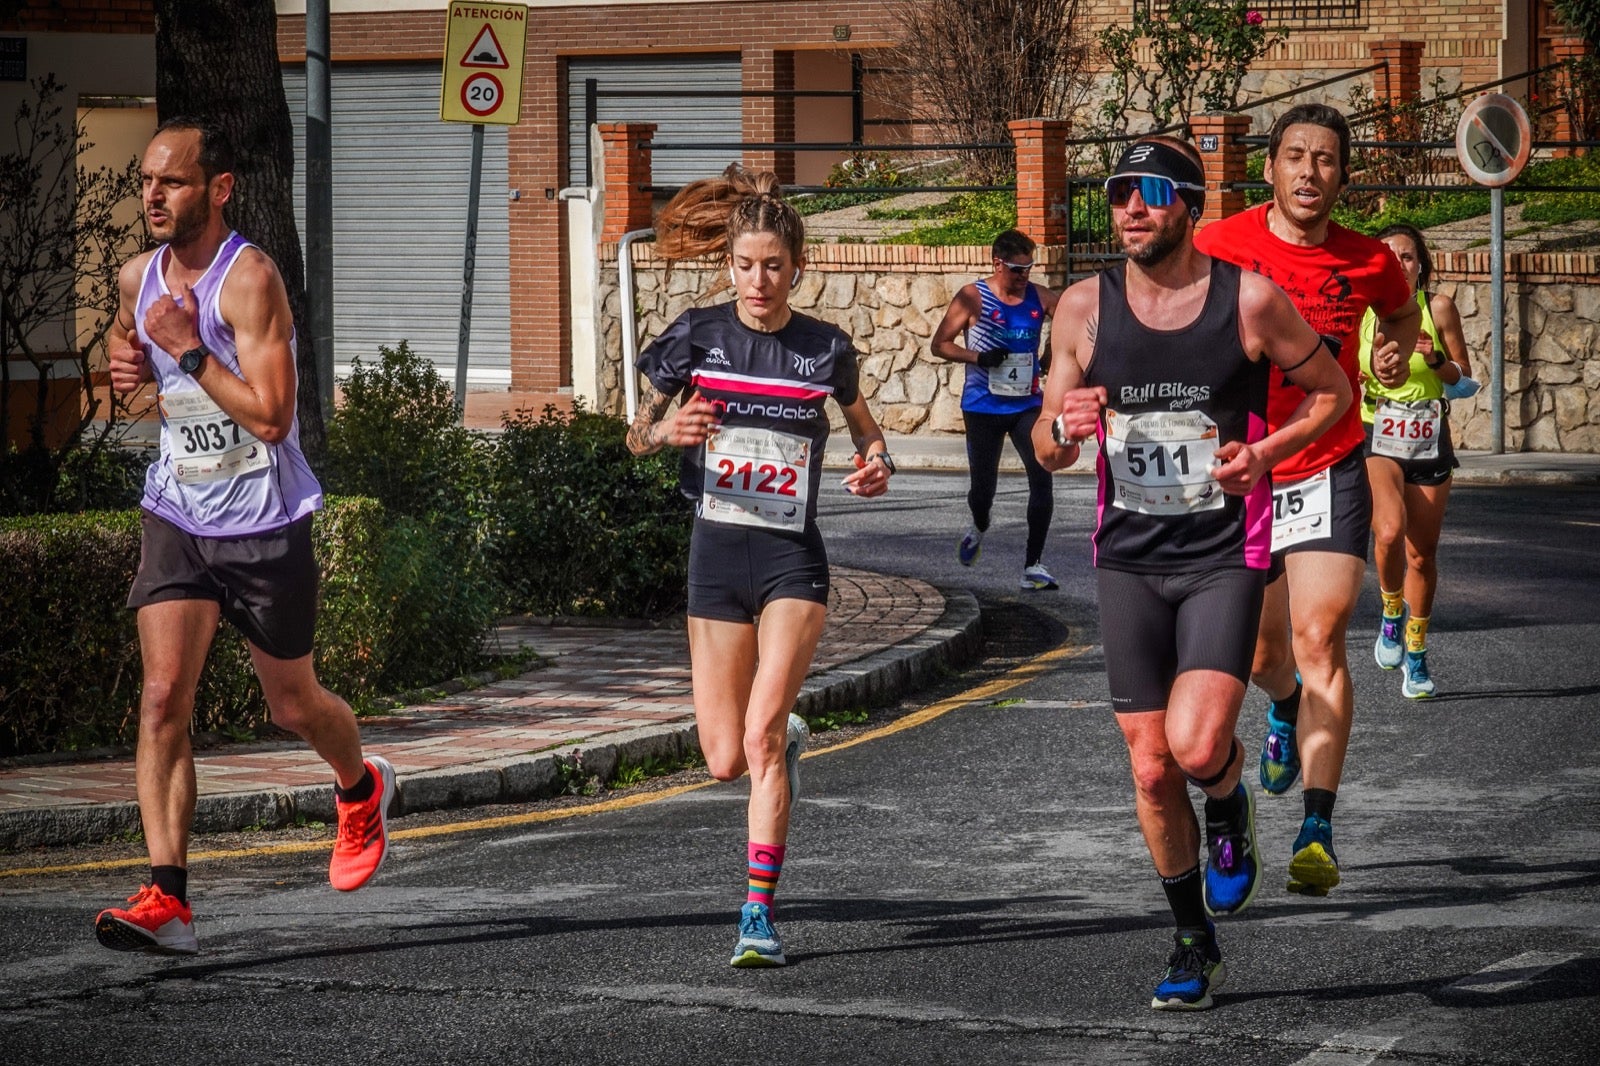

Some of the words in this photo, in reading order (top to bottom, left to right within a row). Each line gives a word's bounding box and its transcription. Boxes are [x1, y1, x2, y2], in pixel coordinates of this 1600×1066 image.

[453, 7, 524, 21] ATENCIÓN
[470, 86, 495, 101] 20
[1008, 368, 1018, 381] 4
[1120, 383, 1156, 400] Bull
[1158, 382, 1210, 397] Bikes
[180, 418, 241, 454] 3037
[1381, 418, 1434, 439] 2136
[1127, 444, 1190, 478] 511
[716, 458, 798, 497] 2122
